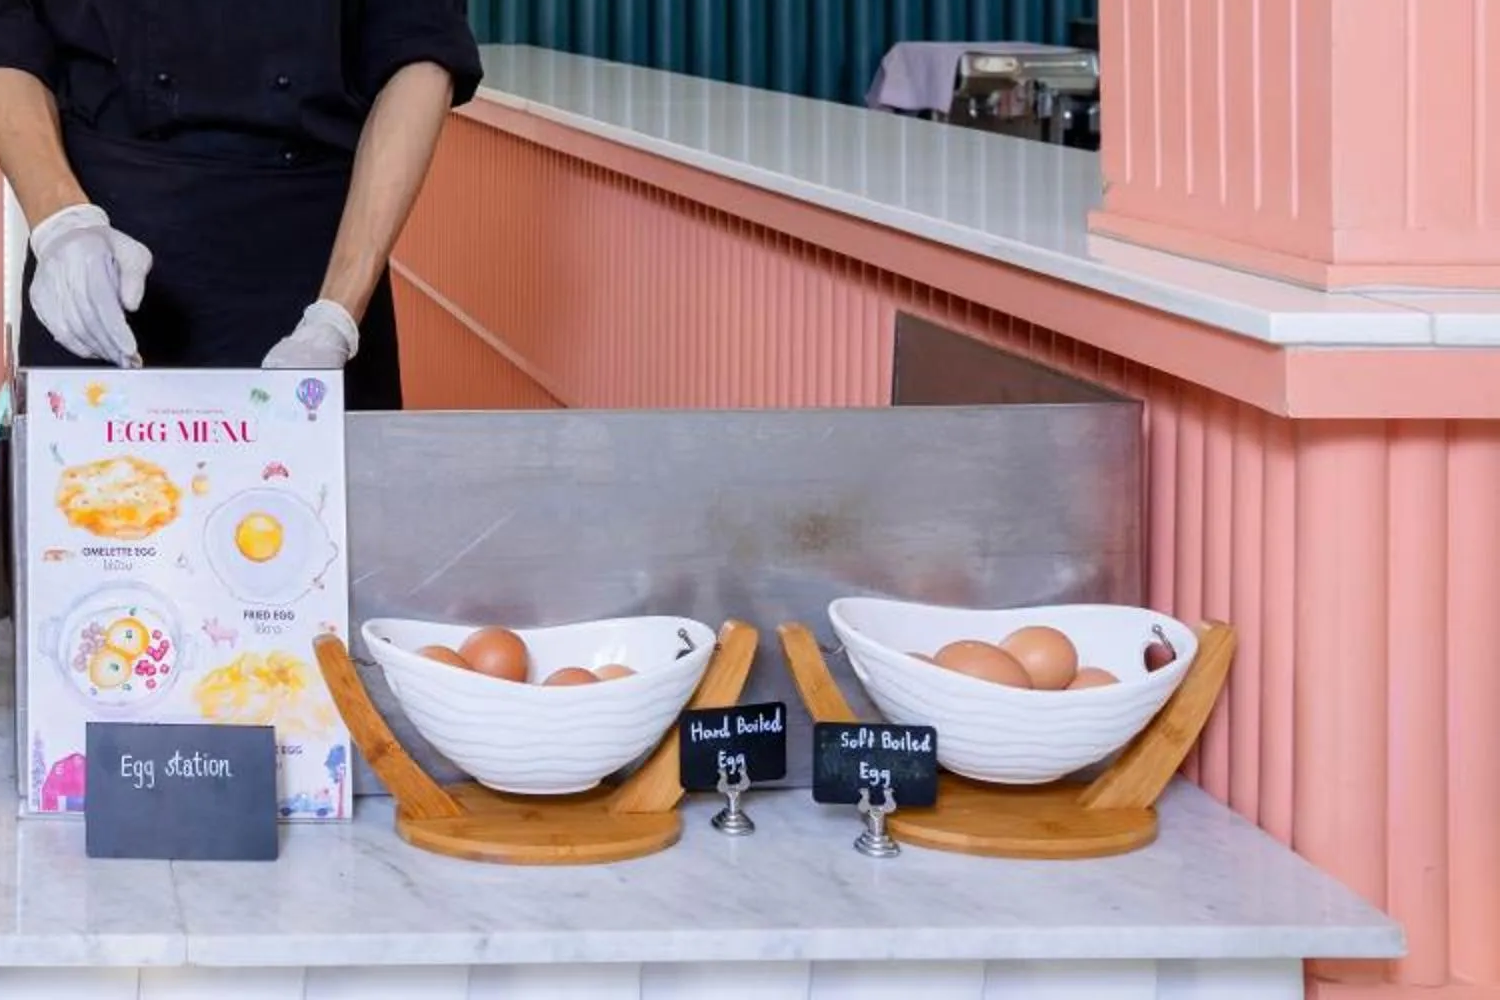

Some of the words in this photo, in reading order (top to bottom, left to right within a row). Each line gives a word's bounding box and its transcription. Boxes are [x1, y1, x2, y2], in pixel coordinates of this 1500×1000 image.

[107, 421, 167, 443] EGG
[177, 421, 258, 443] MENU
[82, 547, 133, 557] OMELETTE
[134, 547, 157, 557] EGG
[691, 714, 731, 743] Hard
[737, 706, 783, 735] Boiled
[840, 727, 875, 749] Soft
[881, 731, 932, 753] Boiled
[121, 754, 156, 789] Egg
[164, 750, 233, 778] station
[718, 749, 746, 775] Egg
[859, 761, 891, 788] Egg
